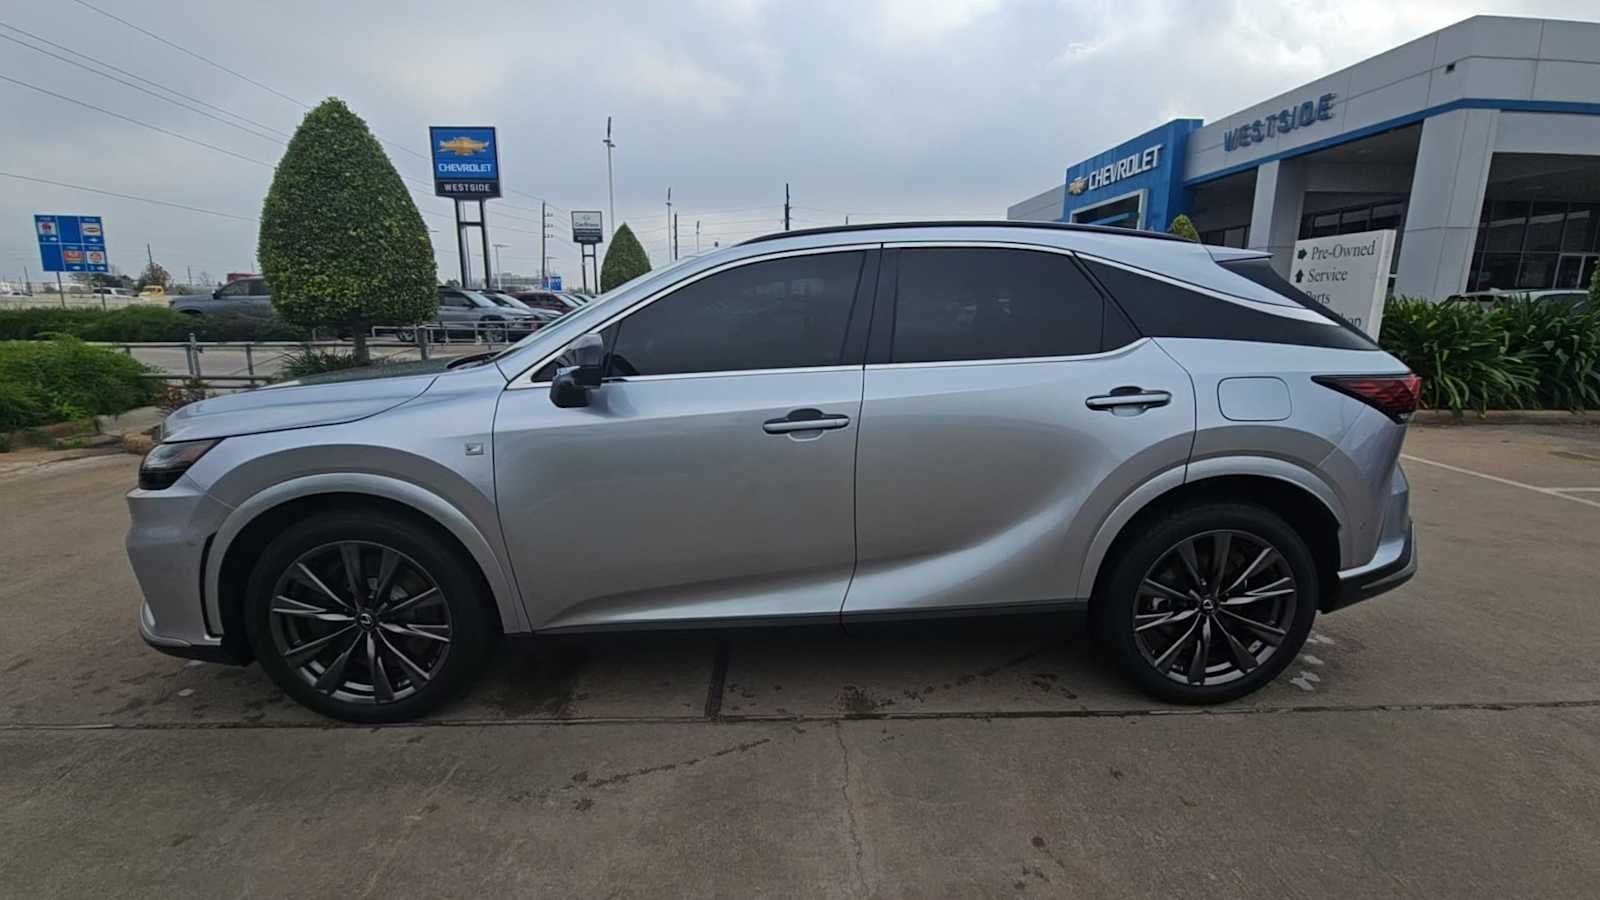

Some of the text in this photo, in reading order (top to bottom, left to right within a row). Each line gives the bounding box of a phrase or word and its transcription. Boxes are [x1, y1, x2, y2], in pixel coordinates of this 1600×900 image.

[1224, 93, 1336, 152] WESTSIDE
[438, 163, 491, 172] CHEVROLET
[1088, 144, 1164, 191] CHEVROLET
[444, 183, 491, 192] WESTSIDE
[1311, 240, 1376, 260] Pre-Owned
[1307, 267, 1348, 282] Service
